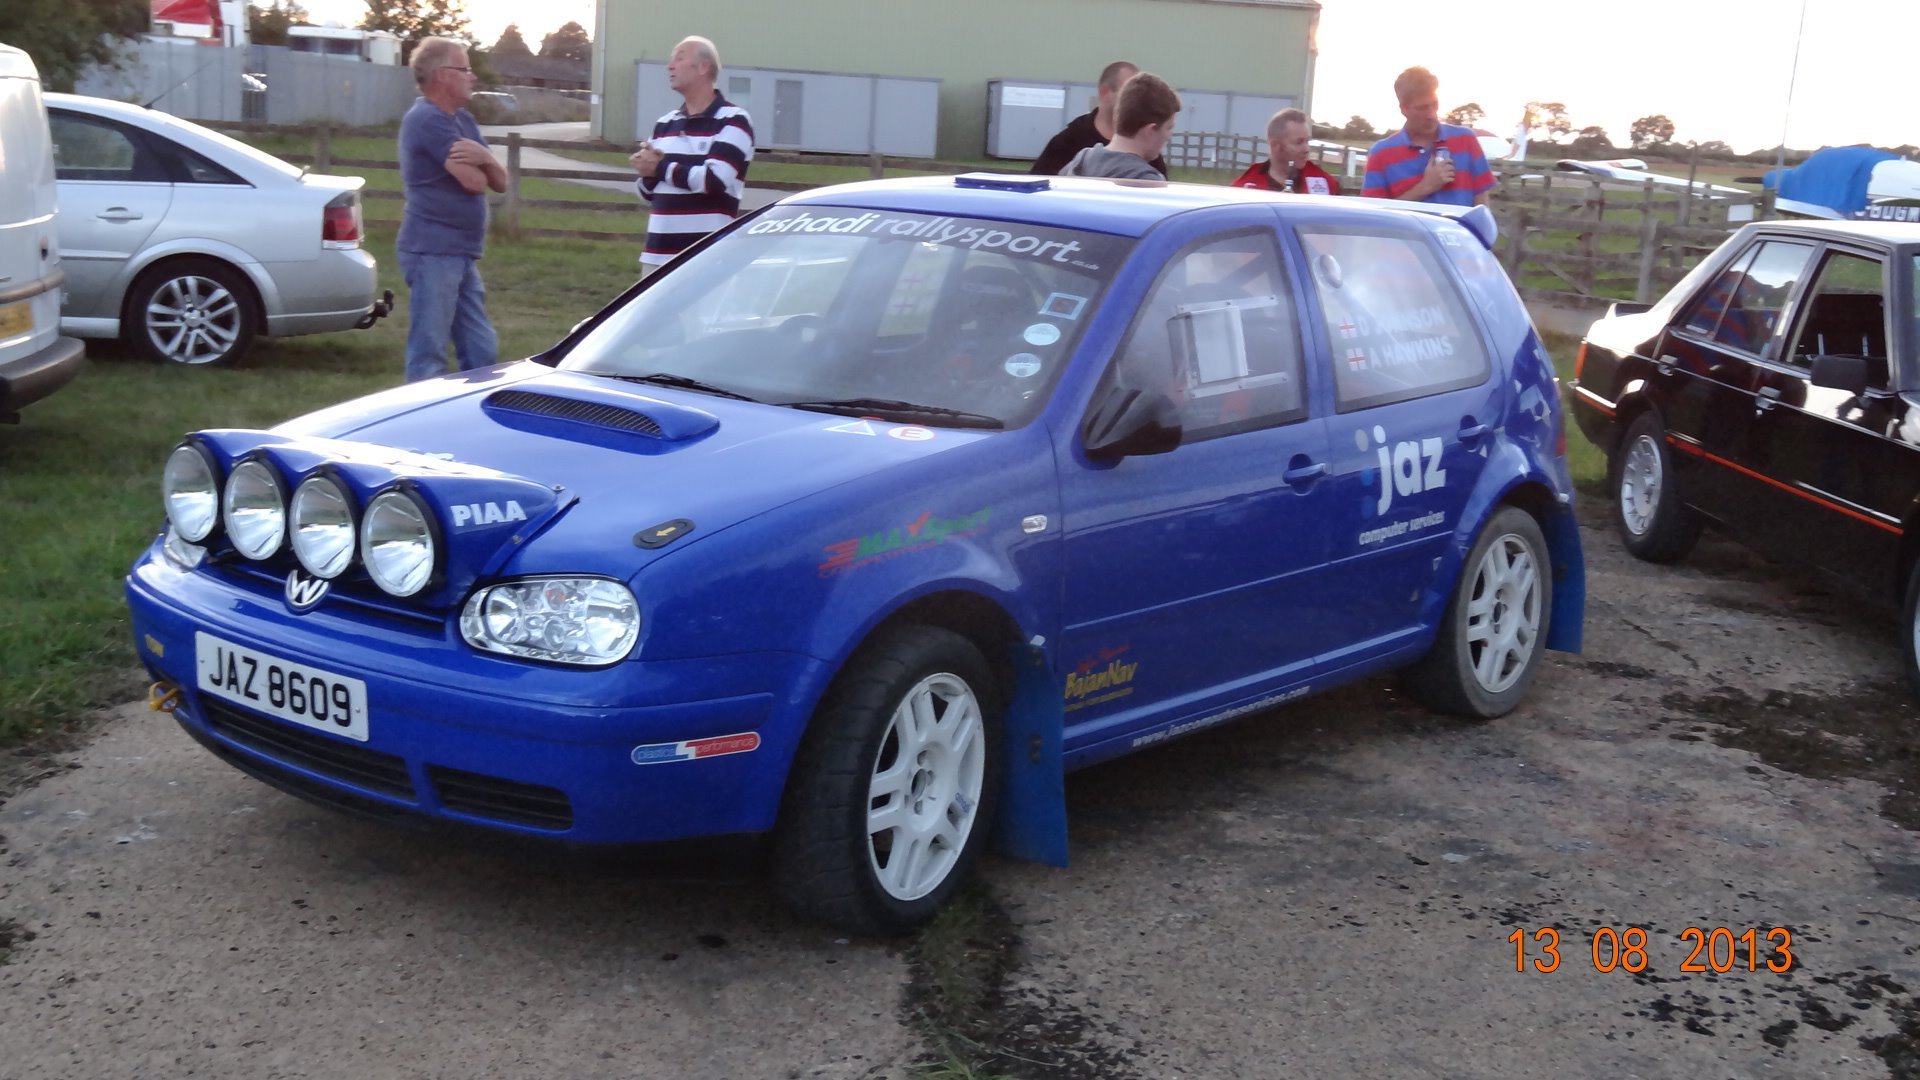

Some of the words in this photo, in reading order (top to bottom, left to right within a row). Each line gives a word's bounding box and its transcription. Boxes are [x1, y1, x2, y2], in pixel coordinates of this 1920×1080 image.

[747, 212, 881, 235] ashadi
[870, 215, 1081, 262] rallysport
[1369, 346, 1383, 369] A
[1382, 335, 1454, 368] HAWKINS
[1373, 425, 1446, 516] jaz
[450, 500, 528, 527] PIAA
[1359, 521, 1408, 545] computer
[1410, 510, 1445, 531] services
[209, 647, 260, 701] JAZ
[268, 665, 352, 728] 8609
